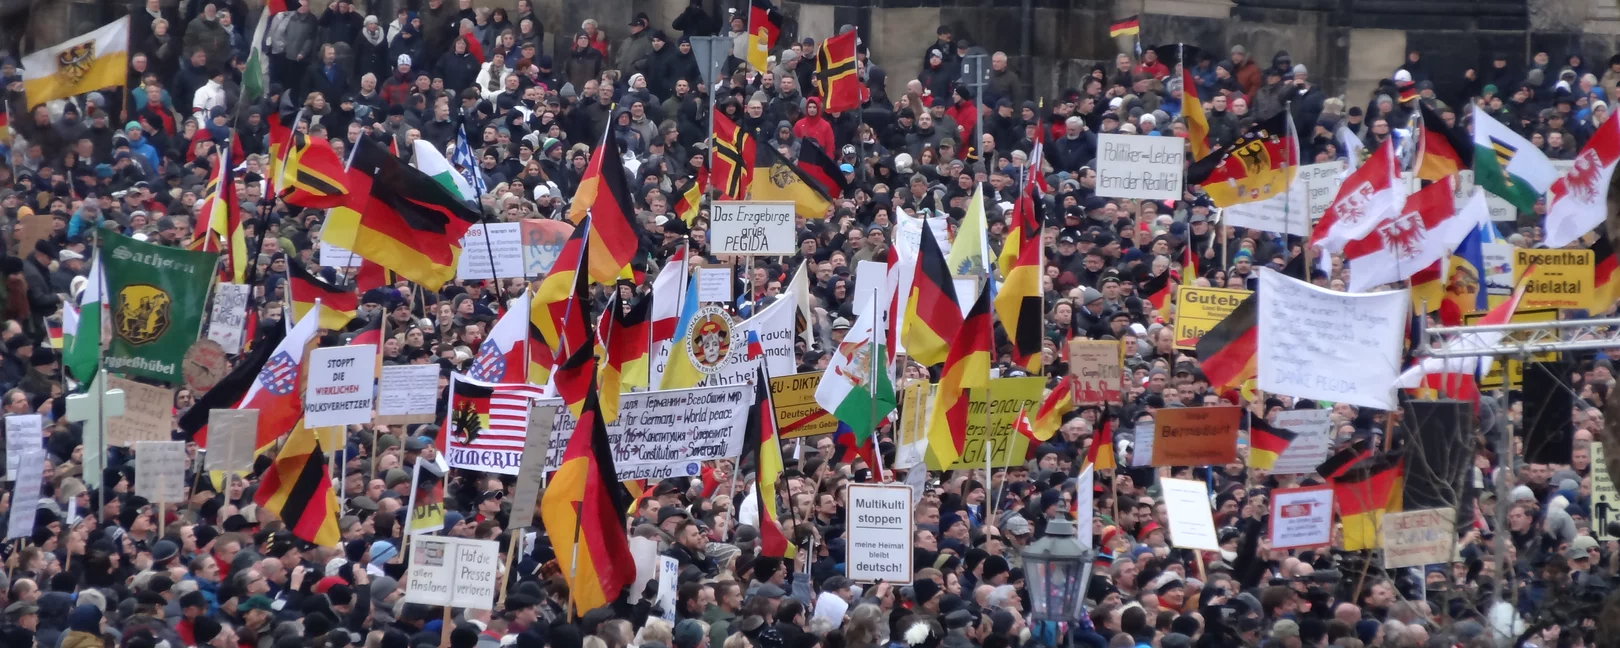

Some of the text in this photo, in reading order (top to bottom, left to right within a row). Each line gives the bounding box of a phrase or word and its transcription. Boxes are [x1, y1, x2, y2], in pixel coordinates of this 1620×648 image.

[713, 206, 790, 226] Das Erzgebirge
[724, 236, 769, 252] PEGIDA
[112, 244, 194, 274] Sachsen
[1518, 252, 1590, 266] Rosenthal
[1185, 292, 1241, 306] Guteb
[327, 358, 355, 368] STOPPT
[332, 372, 345, 382] DIE
[316, 384, 360, 396] WIRKLICHEN
[306, 398, 370, 412] VOLKSVERHETZER!
[640, 411, 676, 427] Germany
[684, 407, 708, 424] World
[708, 408, 732, 424] peace
[638, 444, 680, 460] Constitution
[856, 498, 905, 510] Multikulti
[858, 514, 902, 525] stoppen
[460, 548, 490, 564] Hat die
[868, 551, 890, 559] bleibt
[413, 568, 432, 578] allen
[460, 566, 490, 582] Presse
[856, 562, 902, 573] deutsch!
[456, 582, 490, 596] verloren
